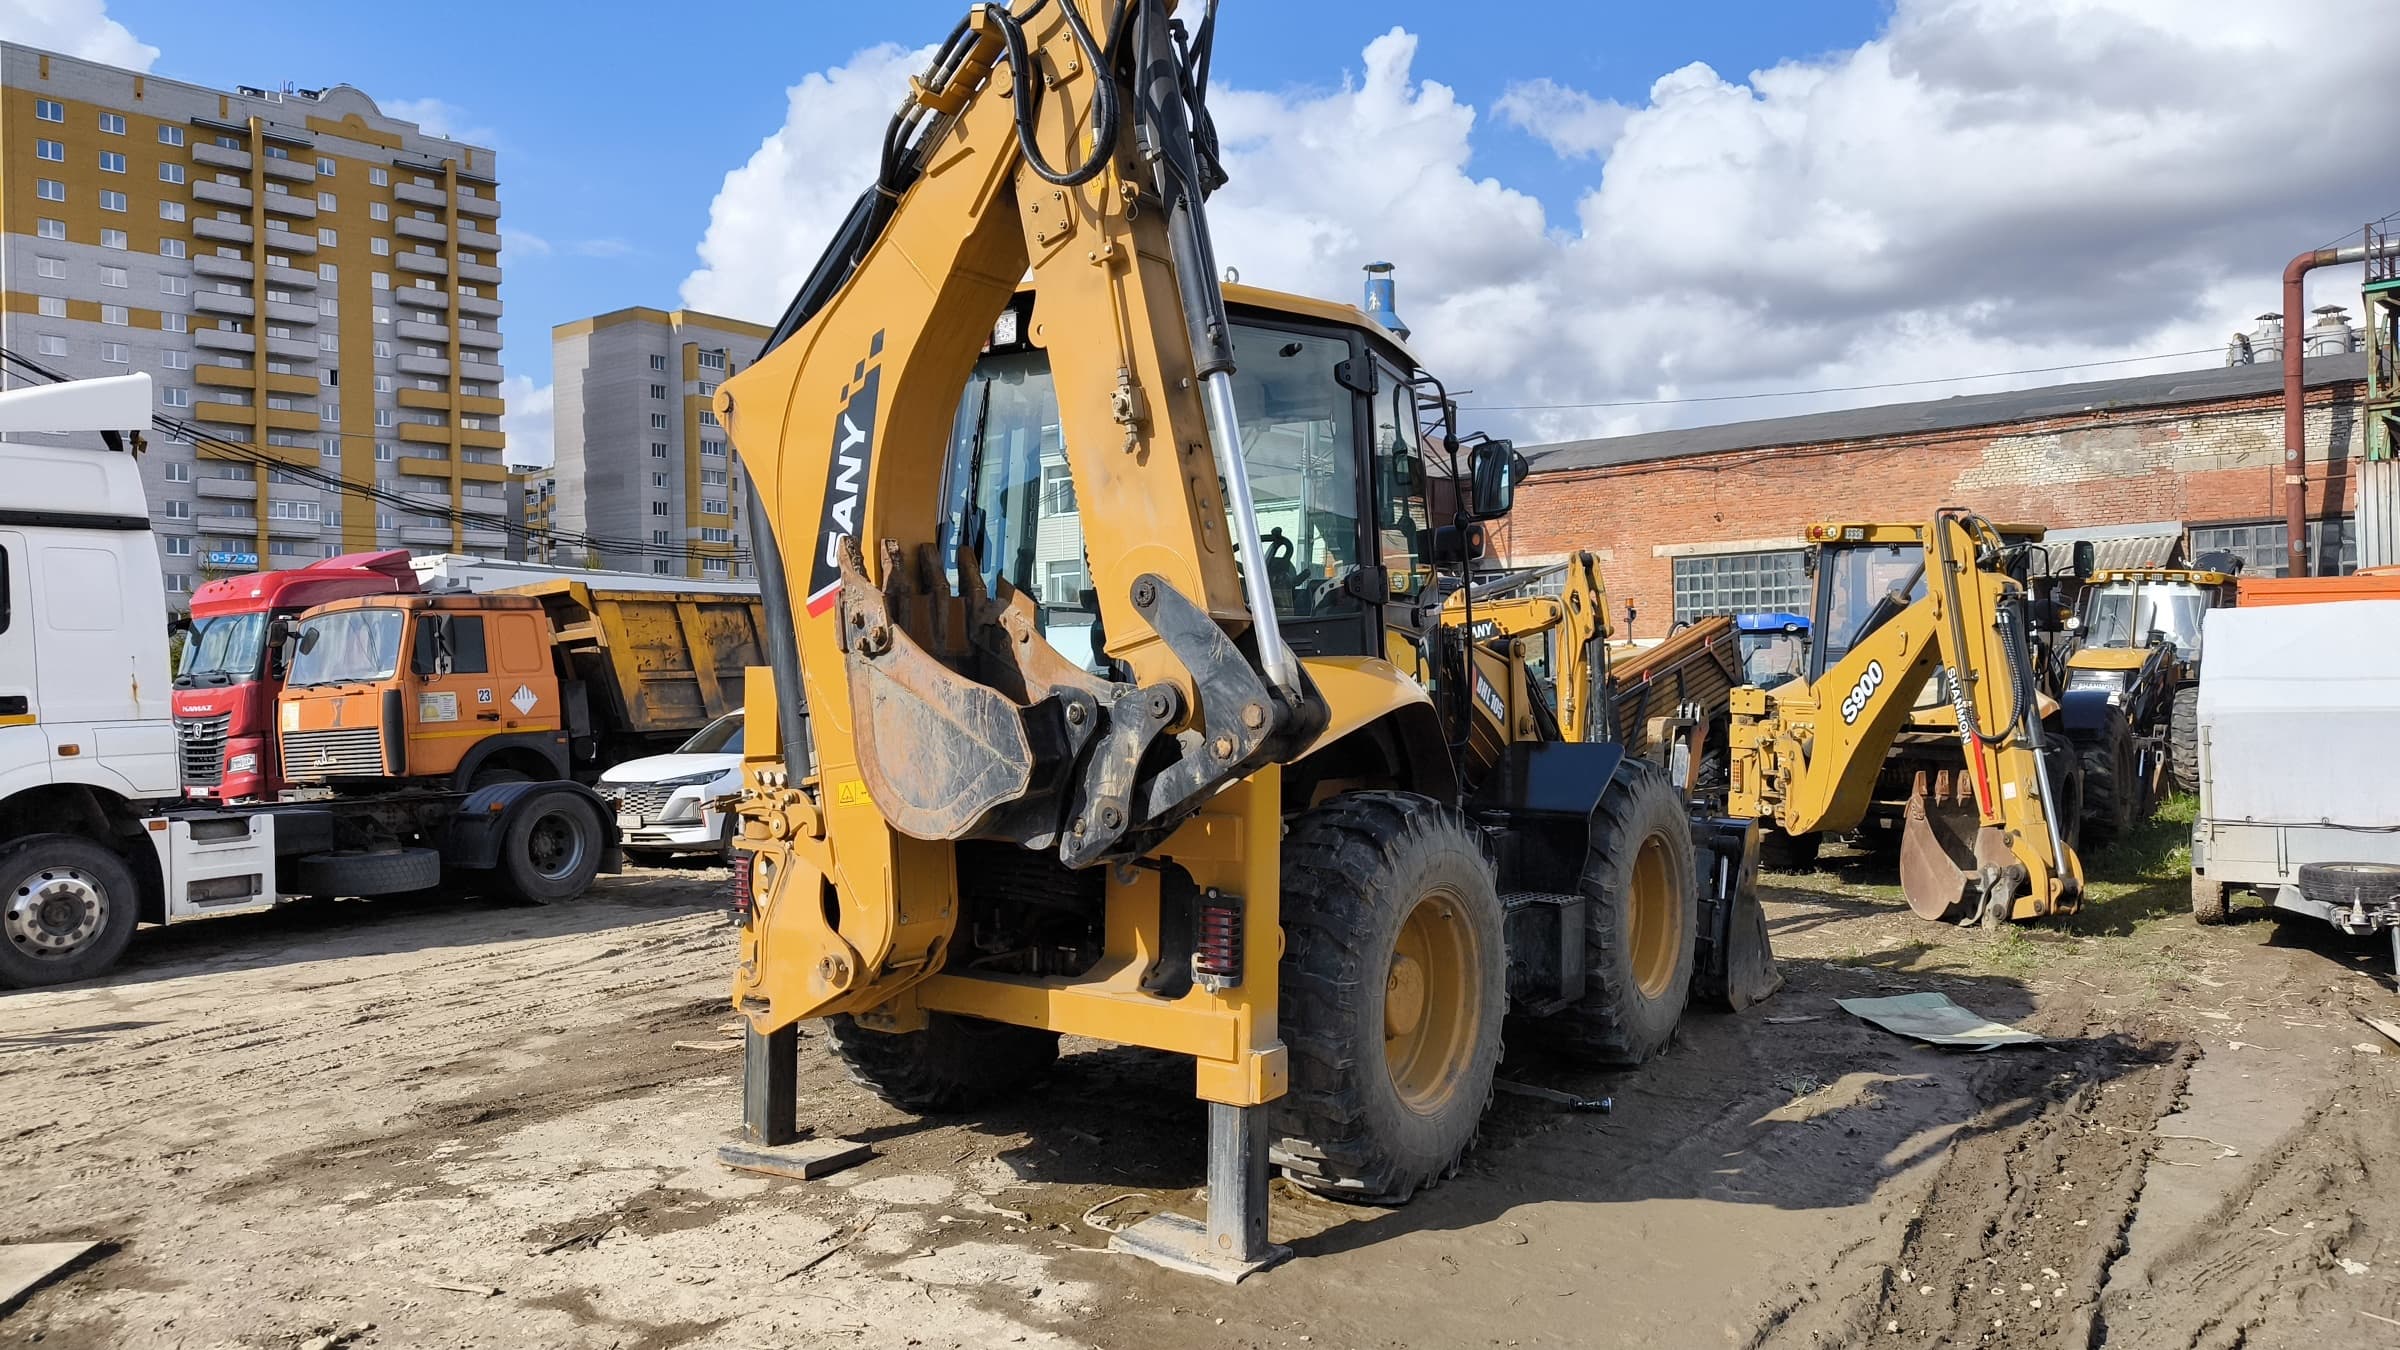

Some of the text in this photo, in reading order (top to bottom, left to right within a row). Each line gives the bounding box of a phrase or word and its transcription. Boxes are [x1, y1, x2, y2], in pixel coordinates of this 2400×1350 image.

[1471, 621, 1492, 639] ANY
[479, 690, 490, 701] 23
[1841, 659, 1884, 725] S900
[182, 704, 213, 712] KAMAZ
[1947, 667, 1971, 745] SHANMON
